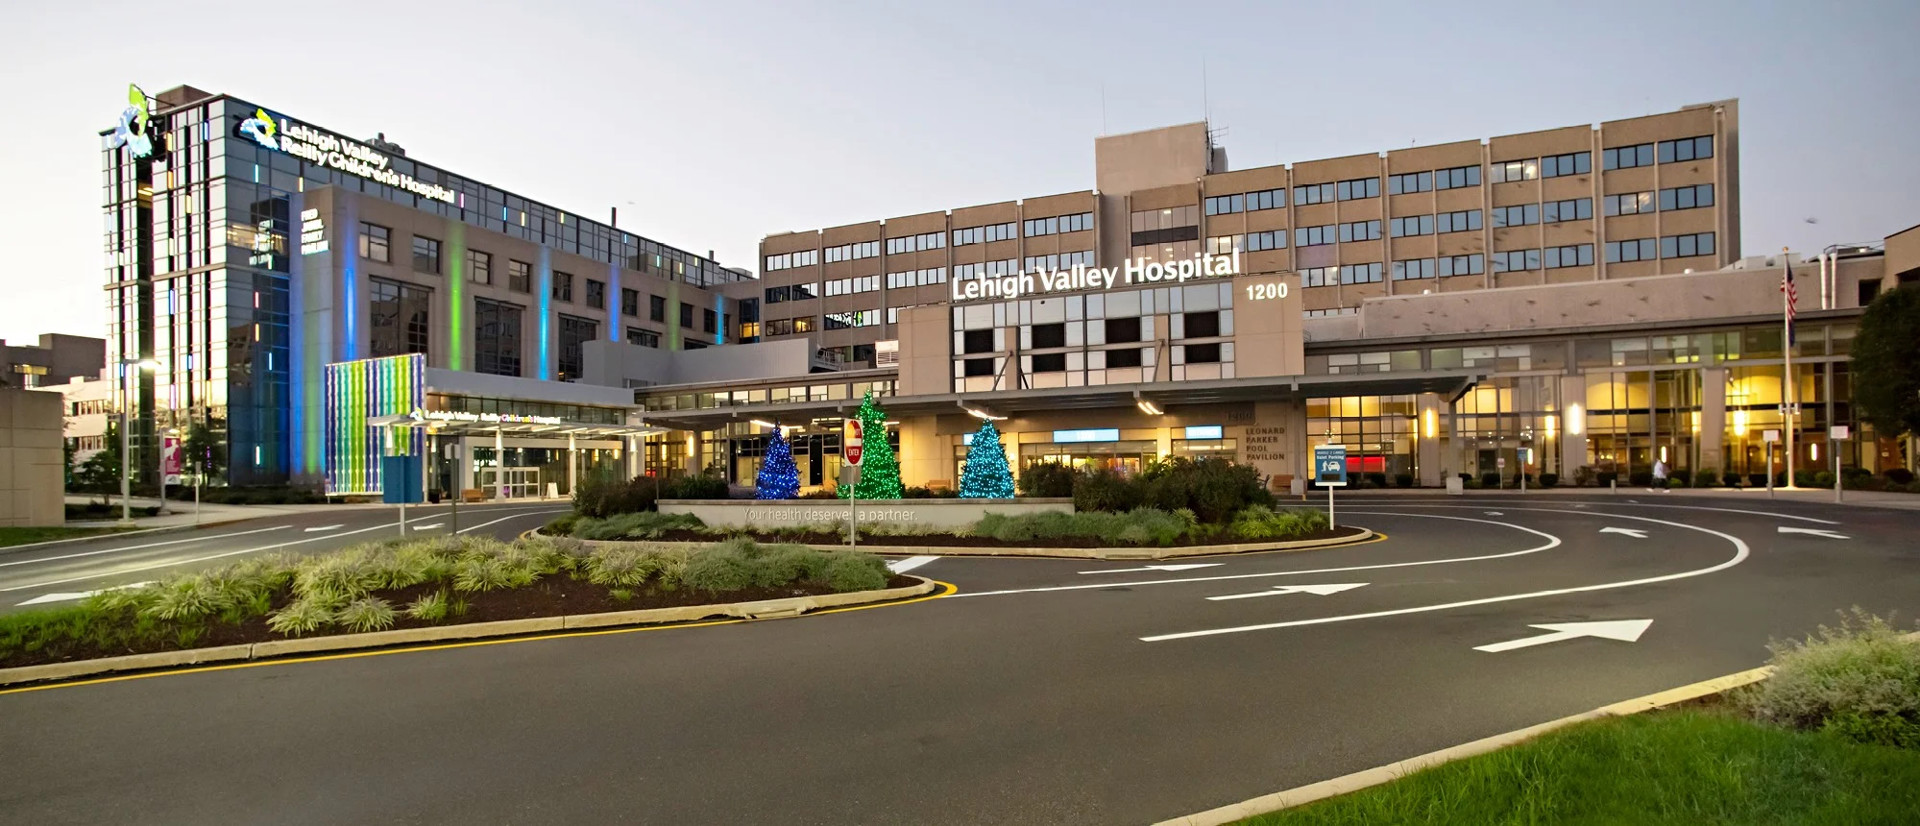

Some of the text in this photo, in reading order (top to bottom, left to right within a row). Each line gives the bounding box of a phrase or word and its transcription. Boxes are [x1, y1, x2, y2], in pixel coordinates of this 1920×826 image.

[280, 118, 388, 170] Lehigh Valley
[280, 135, 329, 167] Reilly
[400, 173, 455, 204] Hospital
[952, 247, 1241, 300] Lehigh Valley Hospital
[1246, 282, 1288, 301] 1200
[425, 410, 455, 421] Lehigh
[454, 411, 480, 423] Valley
[1246, 427, 1285, 435] LEONARD
[743, 508, 768, 520] Your
[769, 507, 802, 521] health
[858, 510, 867, 521] a
[869, 508, 919, 523] partner.
